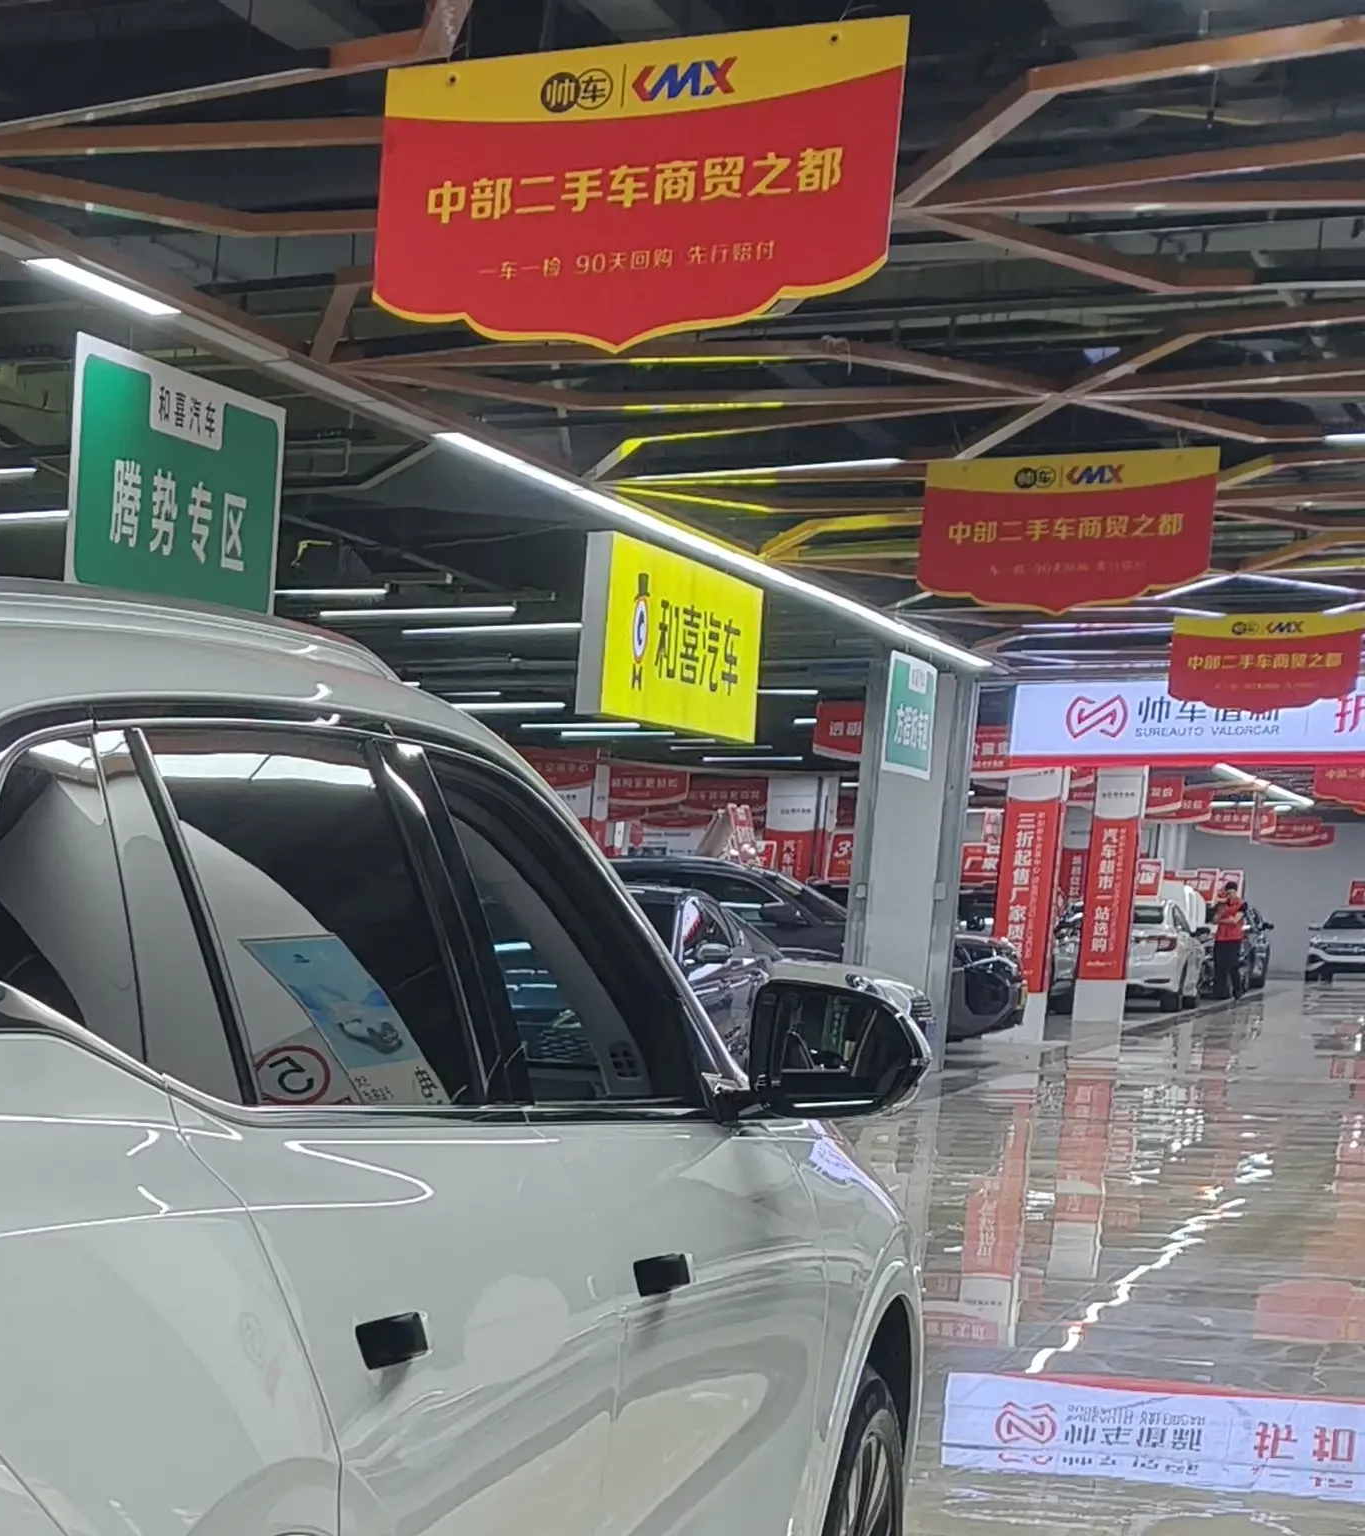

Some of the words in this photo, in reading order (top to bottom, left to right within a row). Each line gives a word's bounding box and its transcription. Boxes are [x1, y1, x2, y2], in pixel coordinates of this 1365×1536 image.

[427, 147, 844, 223] 中部二手车商贸之都
[478, 257, 562, 282] 一车一检
[575, 246, 674, 276] 90天回购
[686, 239, 776, 266] 先行赔付
[157, 384, 218, 441] 和喜汽车
[108, 458, 249, 573] 腾势专区
[947, 512, 1185, 545] 中部二手车商贸之都
[653, 599, 743, 697] 和喜汽车
